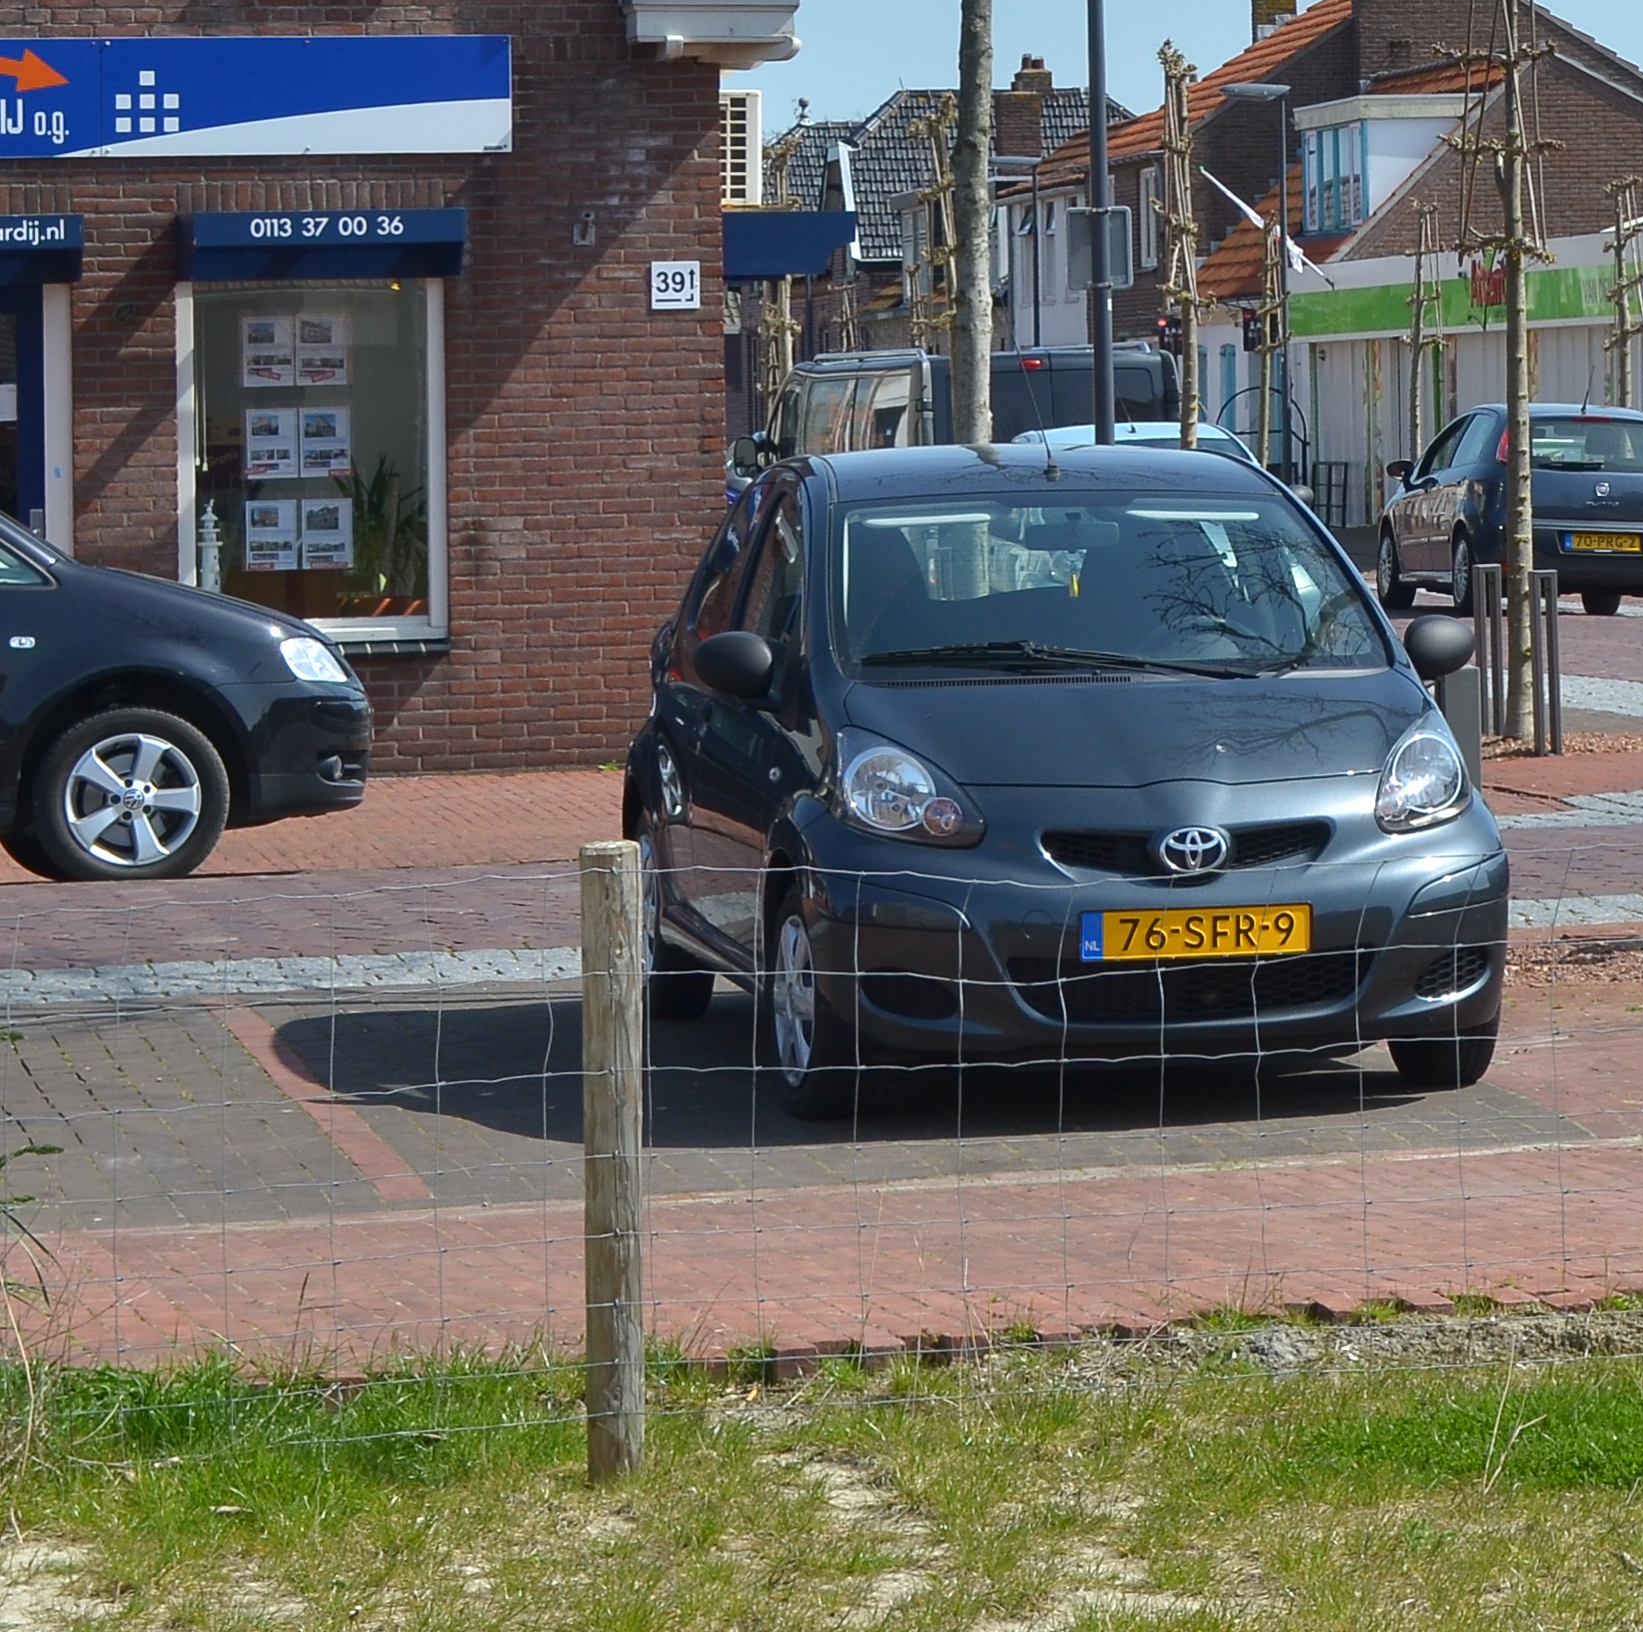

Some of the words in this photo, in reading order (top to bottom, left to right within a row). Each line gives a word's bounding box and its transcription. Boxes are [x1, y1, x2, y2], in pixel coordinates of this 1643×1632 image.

[34, 111, 70, 144] o.g.
[0, 219, 65, 245] rdij.nl
[250, 218, 292, 238] 0113
[301, 217, 329, 237] 37
[338, 216, 367, 236] 00
[376, 215, 404, 236] 36
[656, 271, 685, 293] 39
[1575, 535, 1637, 548] 70-PRG-2
[1119, 909, 1296, 952] 76-SFR-9
[1085, 940, 1100, 952] NL
